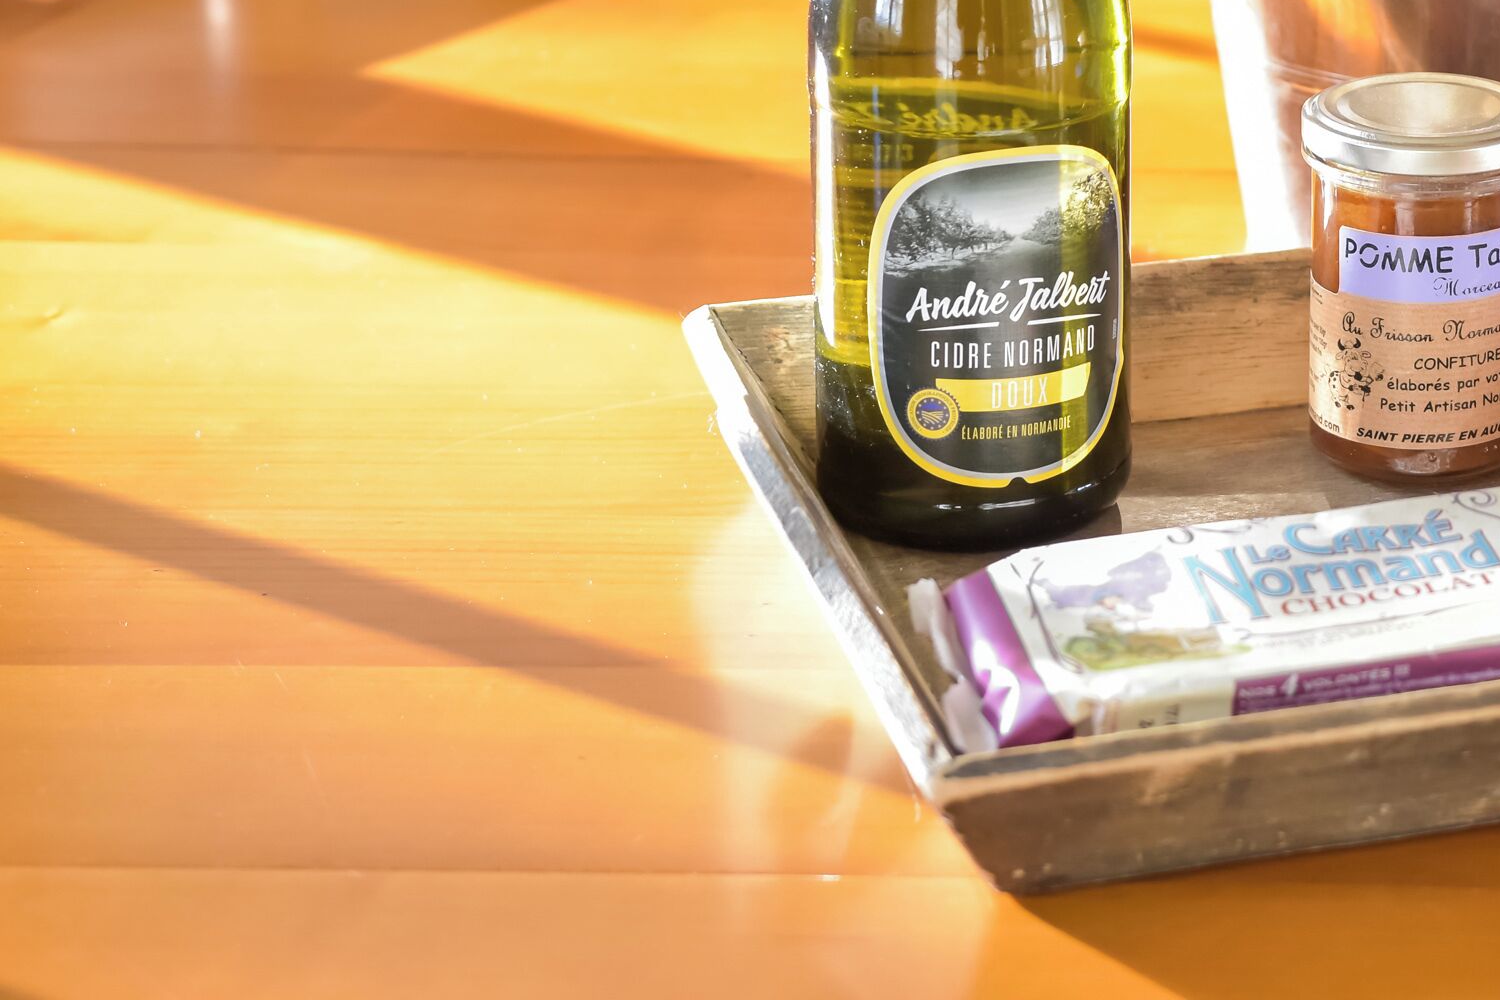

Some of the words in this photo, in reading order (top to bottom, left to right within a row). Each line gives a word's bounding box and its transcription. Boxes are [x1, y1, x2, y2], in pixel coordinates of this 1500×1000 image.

[1345, 237, 1454, 274] POMME
[906, 280, 1009, 323] André
[1010, 270, 1111, 322] Jalbert
[1342, 311, 1363, 336] Au
[1370, 316, 1434, 343] Frisson
[930, 340, 992, 369] CIDRE
[1004, 324, 1096, 368] NORMAND
[991, 376, 1049, 410] DOUX
[1387, 377, 1450, 392] élaborés
[1457, 379, 1480, 393] par
[1380, 398, 1416, 413] Petit
[1423, 398, 1477, 414] Artisan
[961, 425, 1003, 441] ÉLABORÉ
[1006, 422, 1019, 439] EN
[1021, 414, 1072, 437] NORMANDIE
[1356, 427, 1397, 443] SAINT
[1401, 432, 1455, 444] PIERRE
[1458, 430, 1479, 441] EN
[1250, 543, 1291, 564] Le
[1283, 508, 1463, 556] CARRÉ
[1281, 570, 1496, 616] CHOCOLAT
